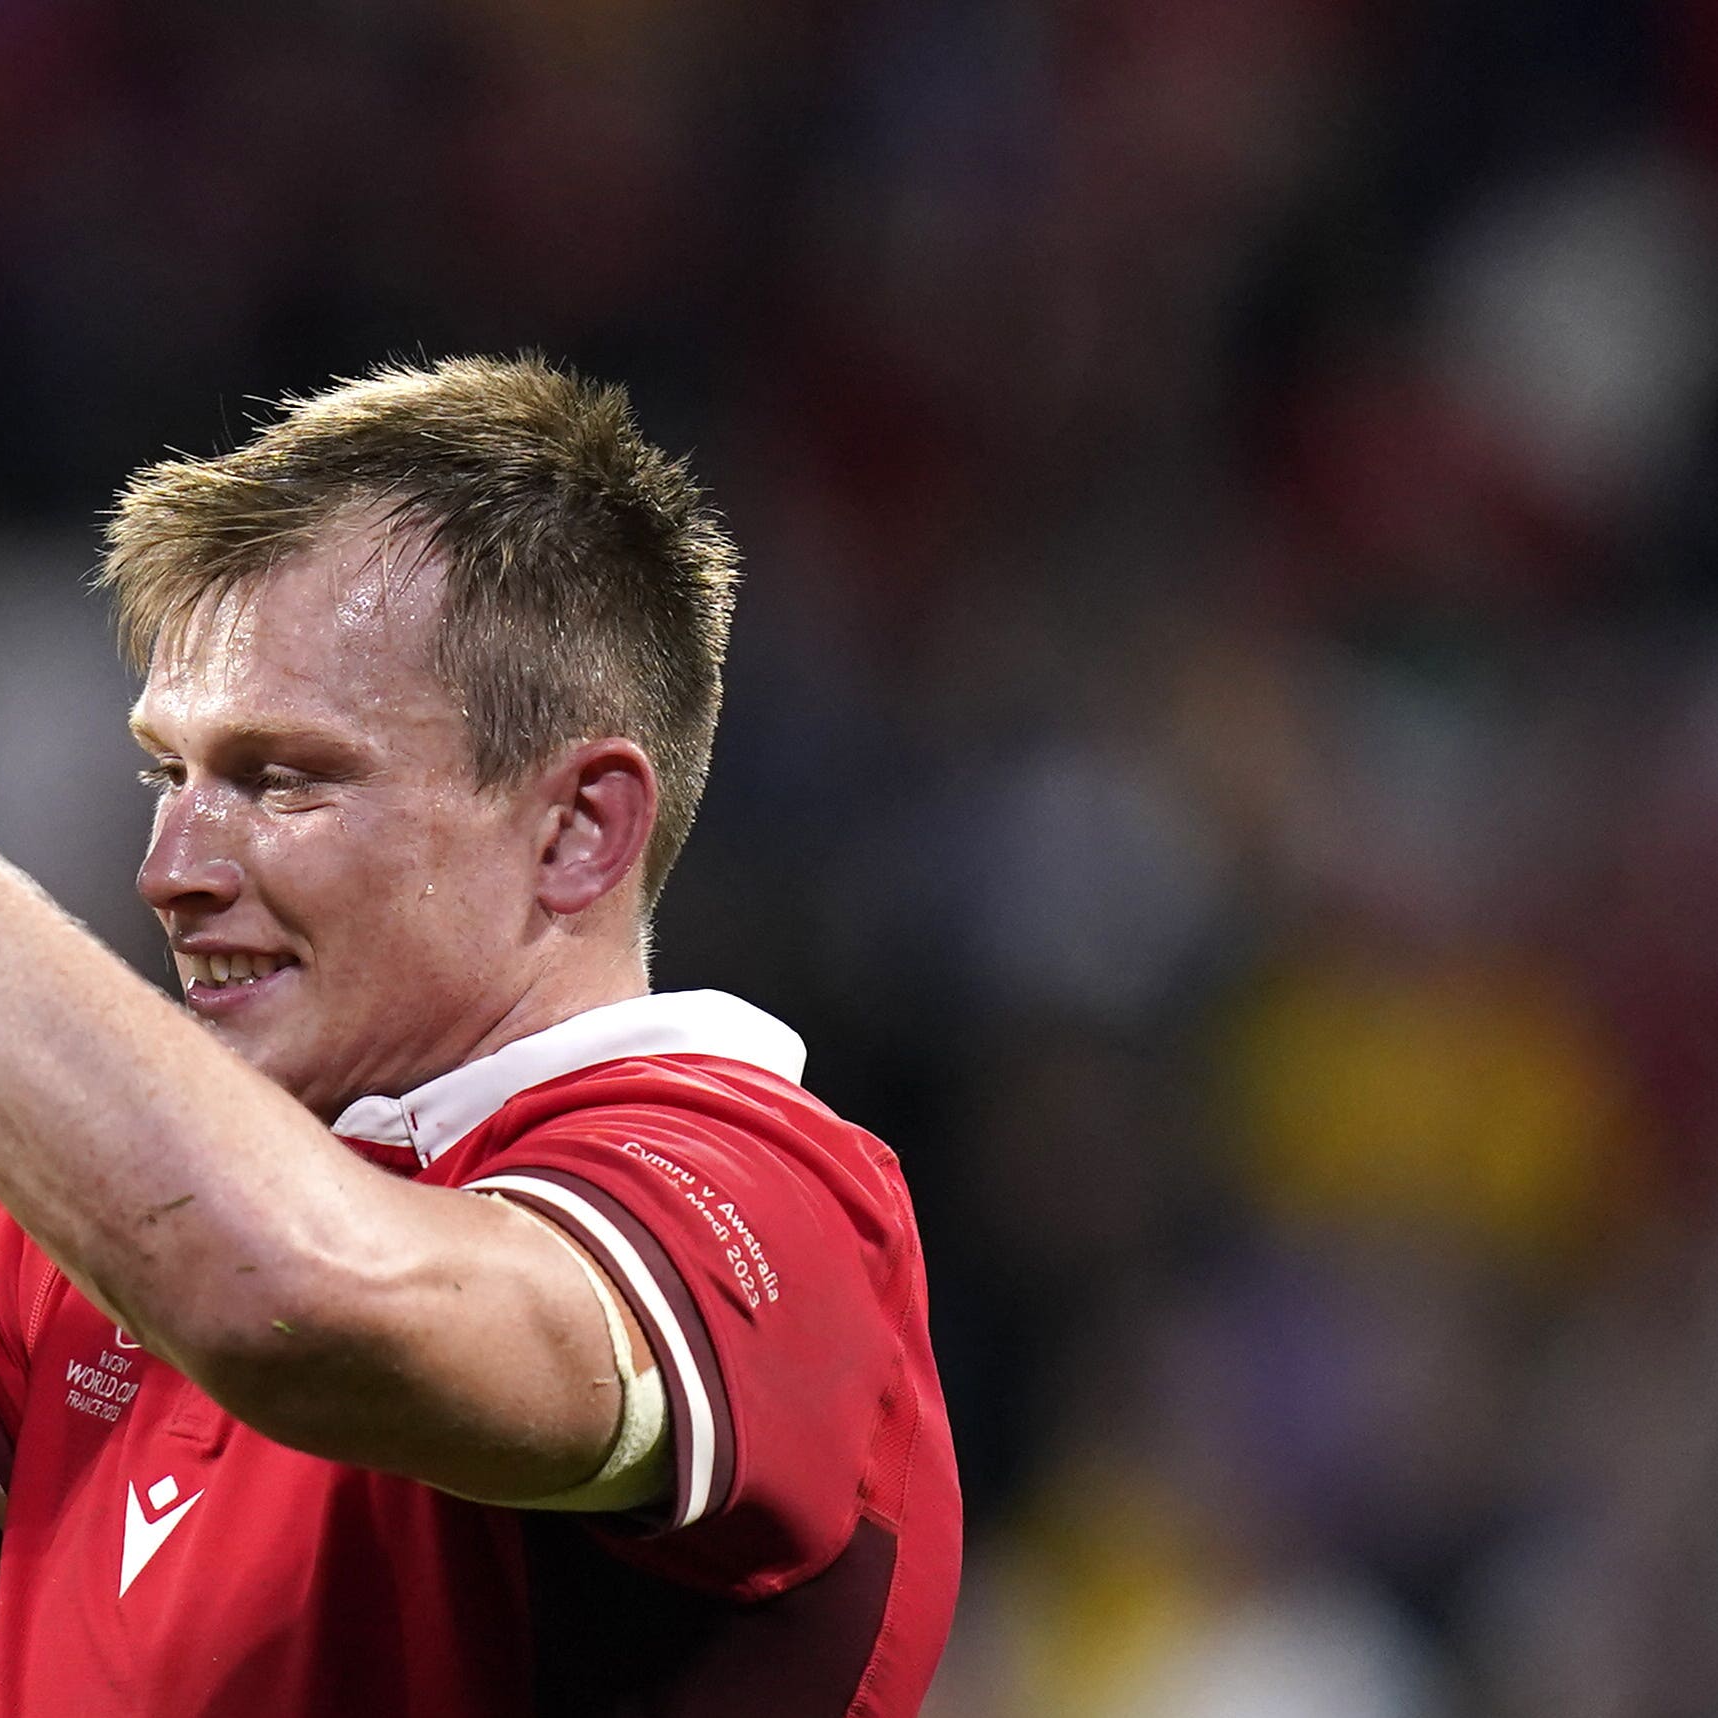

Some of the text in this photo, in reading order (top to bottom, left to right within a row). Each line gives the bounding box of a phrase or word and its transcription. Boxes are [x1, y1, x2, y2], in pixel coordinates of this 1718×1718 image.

[622, 1142, 780, 1304] Cymru v Awstralia
[685, 1192, 761, 1309] Medi 2023
[66, 1359, 140, 1404] WORLD CUP
[98, 1350, 133, 1374] RUGBY
[65, 1389, 122, 1422] FRANCE 2023
